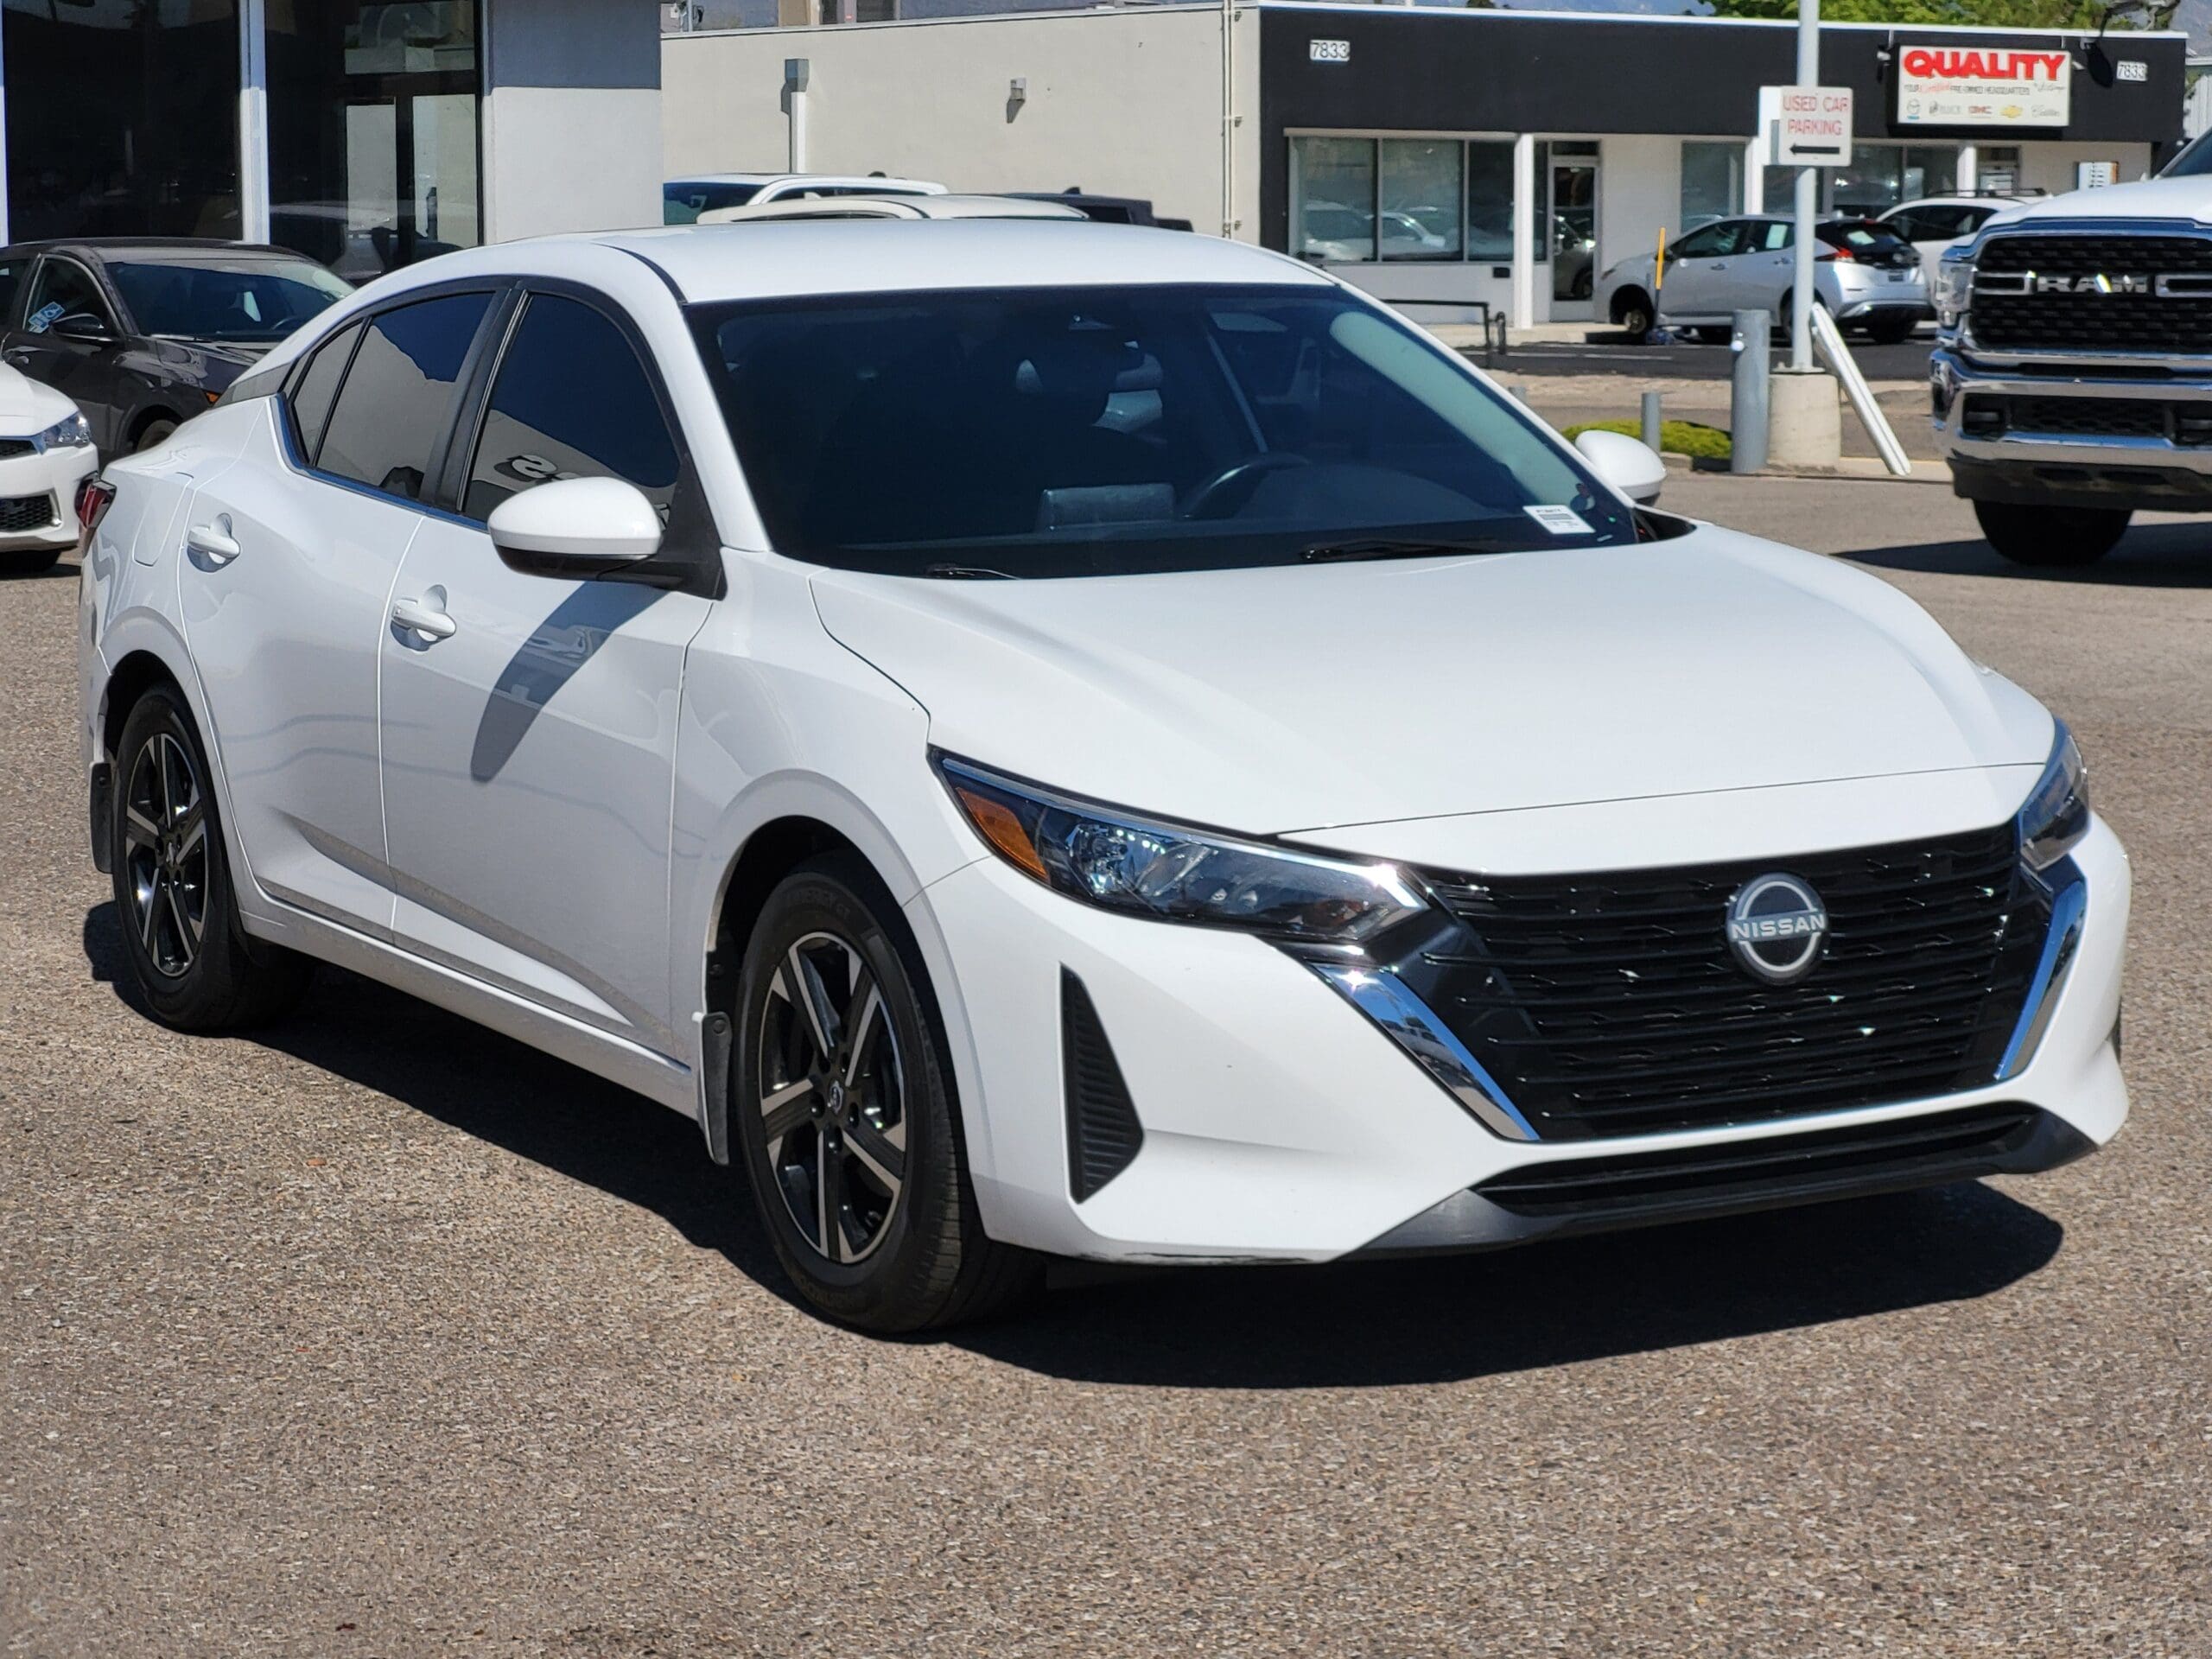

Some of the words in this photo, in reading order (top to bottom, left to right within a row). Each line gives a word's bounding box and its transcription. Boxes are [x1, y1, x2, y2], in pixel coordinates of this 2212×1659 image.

[1311, 42, 1349, 58] 7833
[1904, 50, 2065, 80] QUALITY
[2118, 64, 2145, 78] 7833
[1783, 96, 1817, 111] USED
[1822, 96, 1848, 111] CAR
[1788, 119, 1842, 135] PARKING
[2037, 274, 2148, 293] RAM
[1730, 913, 1826, 939] NISSAN
